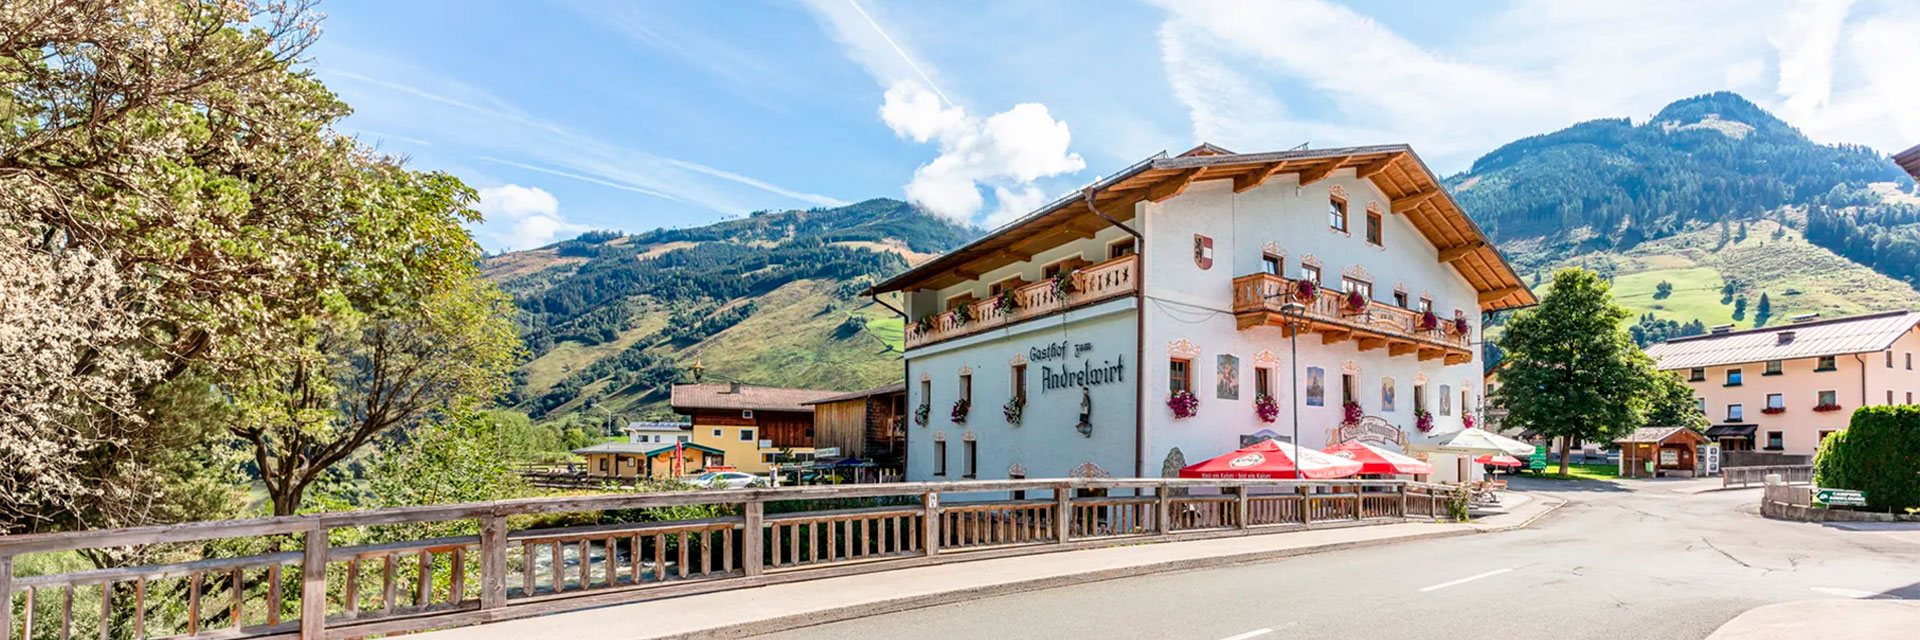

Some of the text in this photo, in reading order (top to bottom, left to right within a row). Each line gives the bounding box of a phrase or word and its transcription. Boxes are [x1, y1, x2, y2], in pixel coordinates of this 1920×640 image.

[1029, 340, 1092, 361] Gasthof zum
[1041, 353, 1123, 394] Andrelwirt
